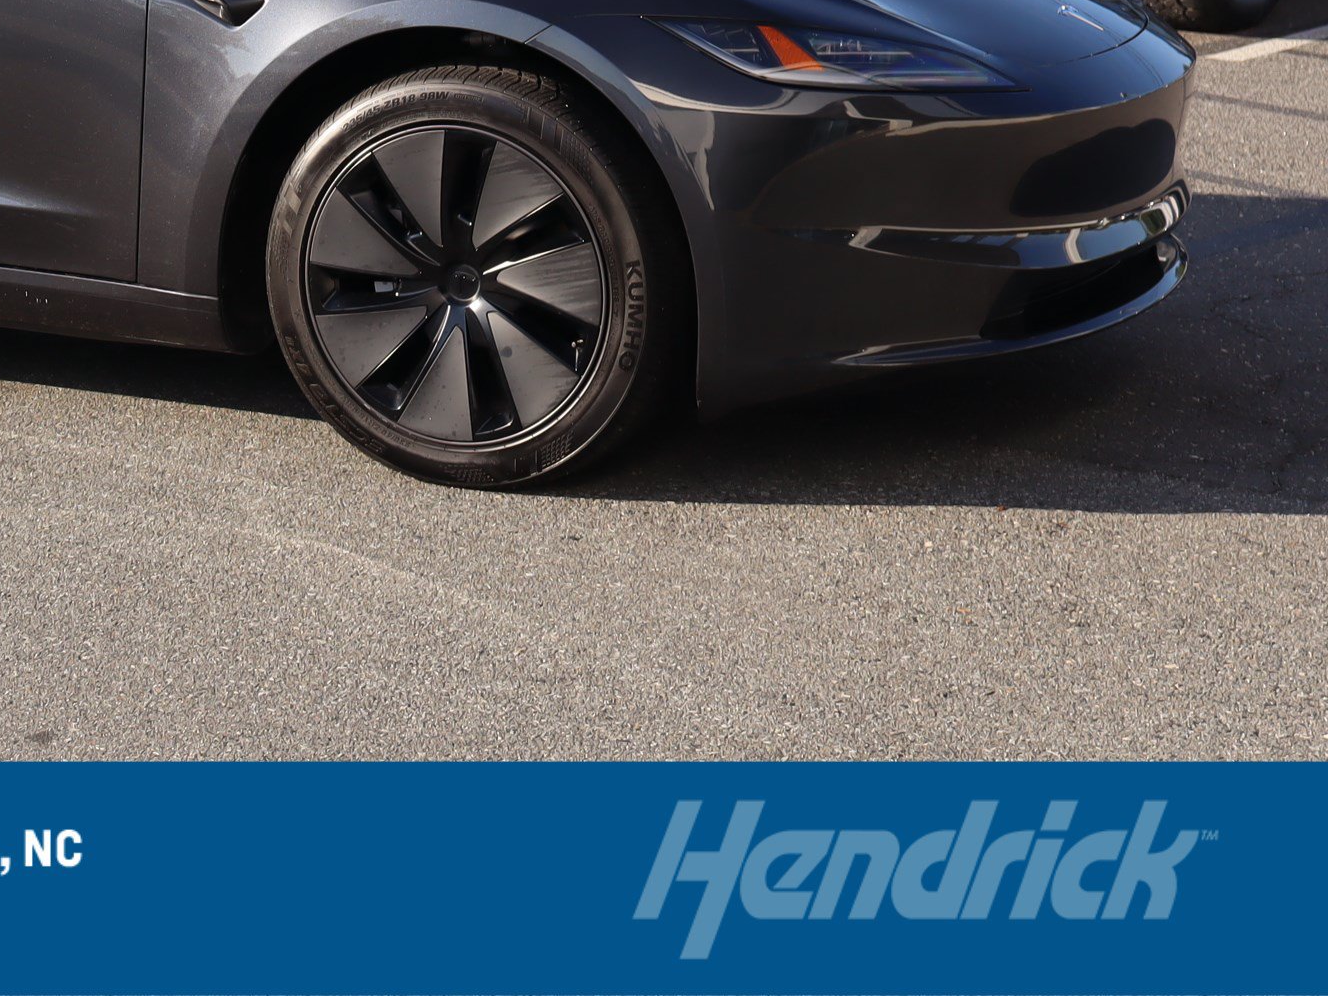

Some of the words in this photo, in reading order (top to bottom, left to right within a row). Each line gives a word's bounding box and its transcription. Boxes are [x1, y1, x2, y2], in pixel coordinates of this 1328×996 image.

[342, 106, 381, 132] 235/45
[383, 94, 416, 109] ZR18
[419, 91, 450, 101] 98W
[618, 259, 645, 372] KUMHO
